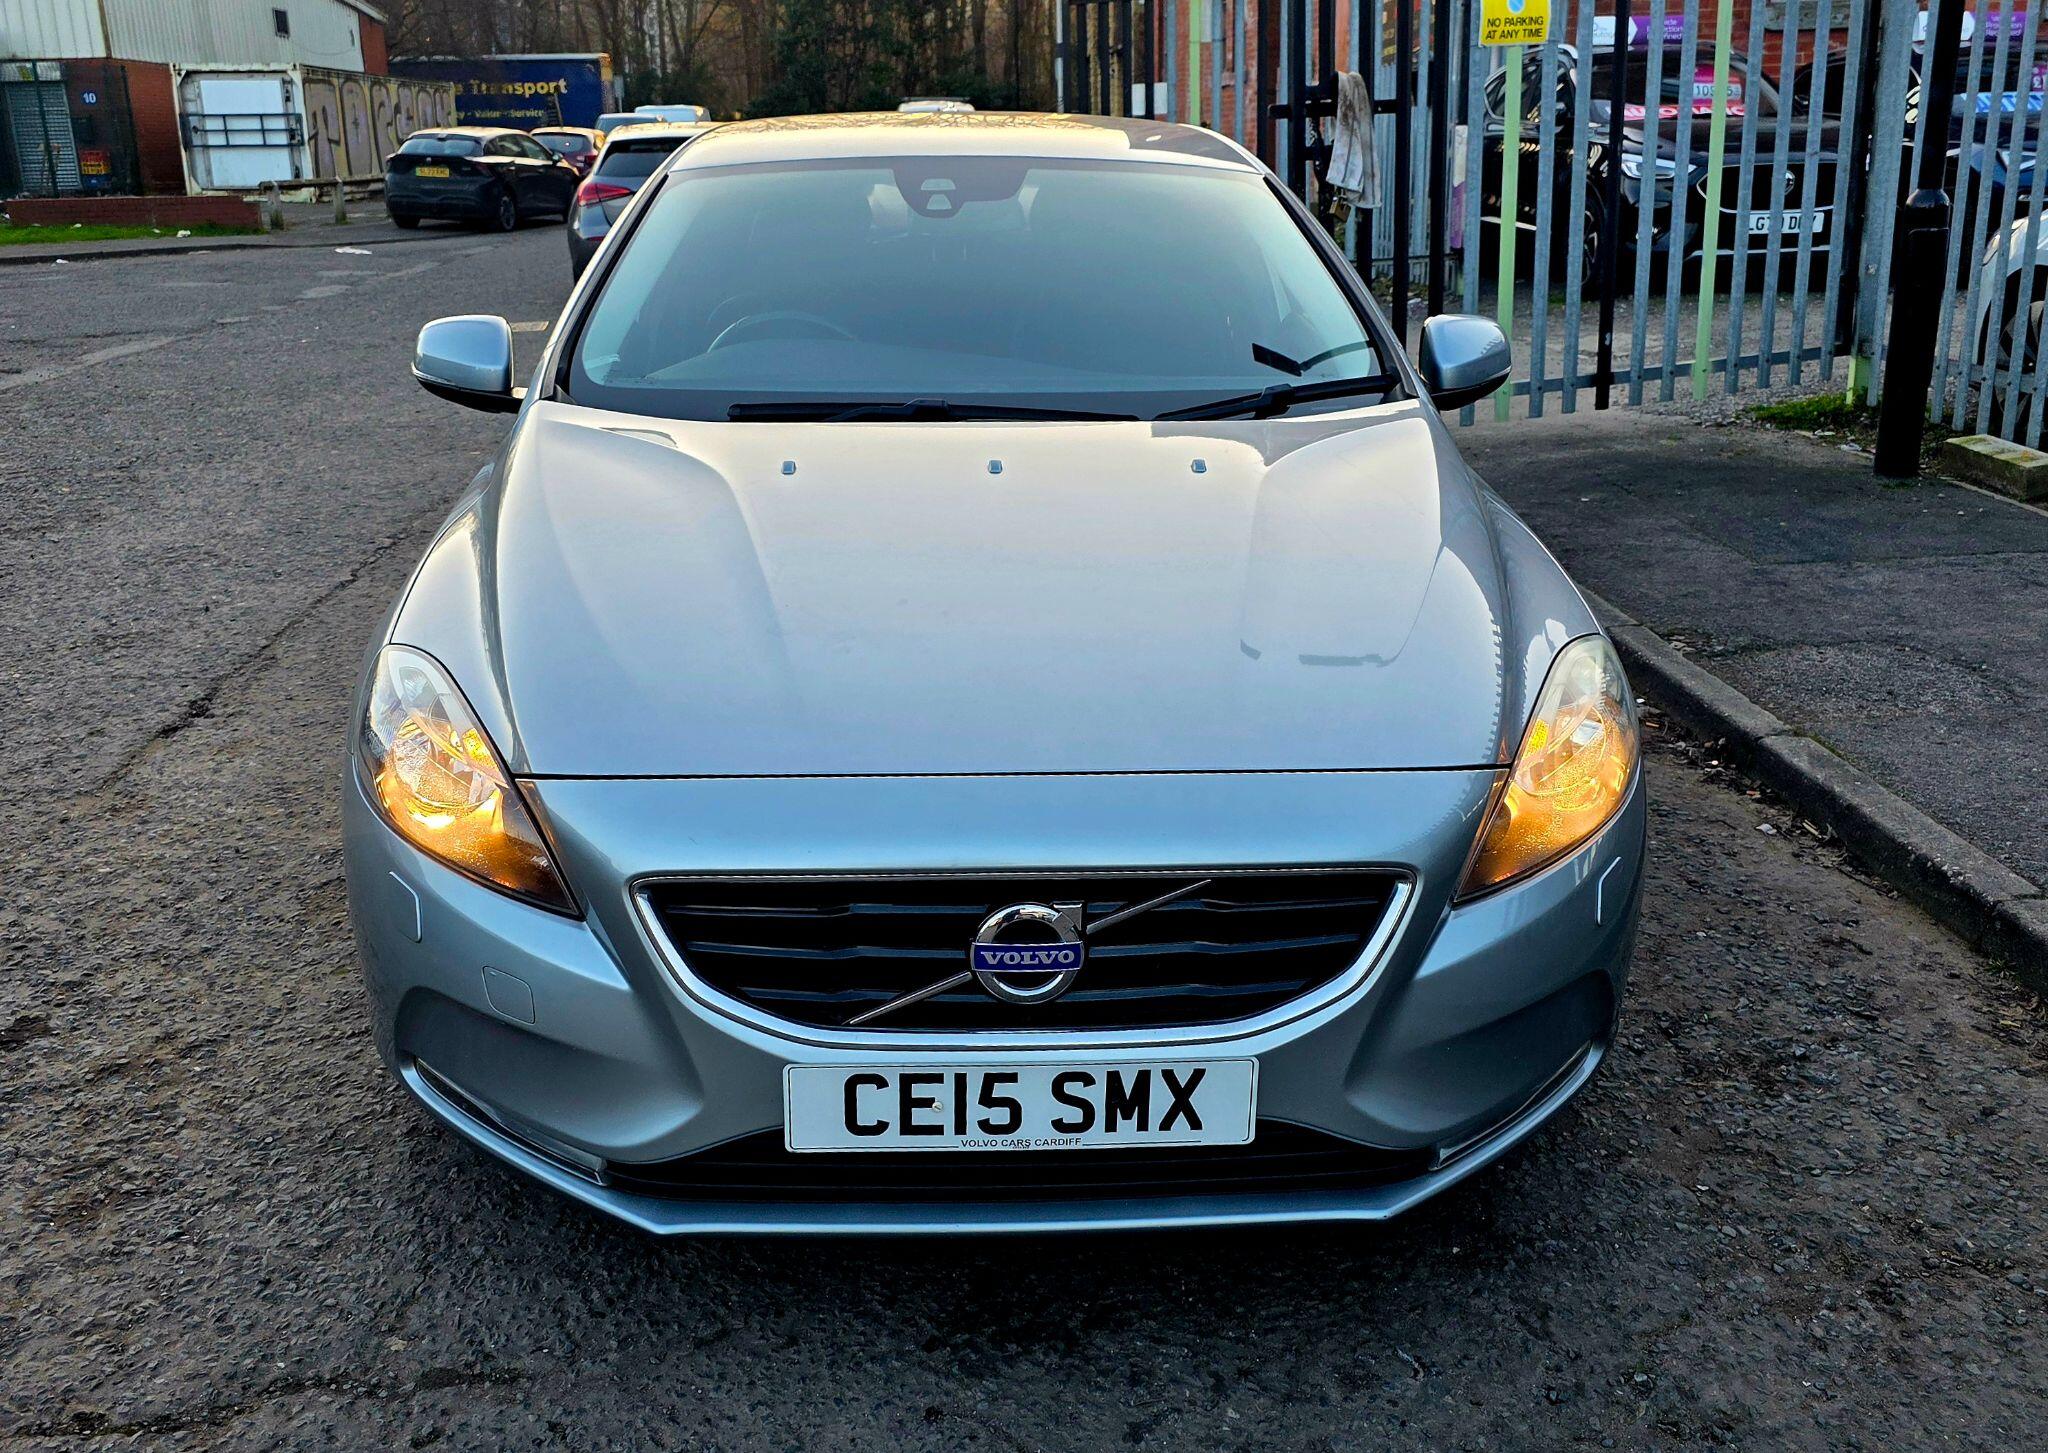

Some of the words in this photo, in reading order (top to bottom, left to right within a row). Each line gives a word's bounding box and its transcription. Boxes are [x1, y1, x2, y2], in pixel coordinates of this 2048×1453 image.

[1487, 18, 1501, 27] NO
[1504, 16, 1544, 26] PARKING
[1485, 30, 1499, 40] AT
[1499, 29, 1520, 39] ANY
[1522, 28, 1543, 38] TIME
[470, 78, 568, 98] Transport
[83, 92, 97, 104] 10
[980, 949, 1075, 965] VOLVO
[843, 1071, 1023, 1137] CE15
[1050, 1067, 1207, 1135] SMX
[961, 1138, 998, 1148] VOLVO
[1001, 1138, 1032, 1147] CARS
[1034, 1137, 1082, 1147] CARDIFF
